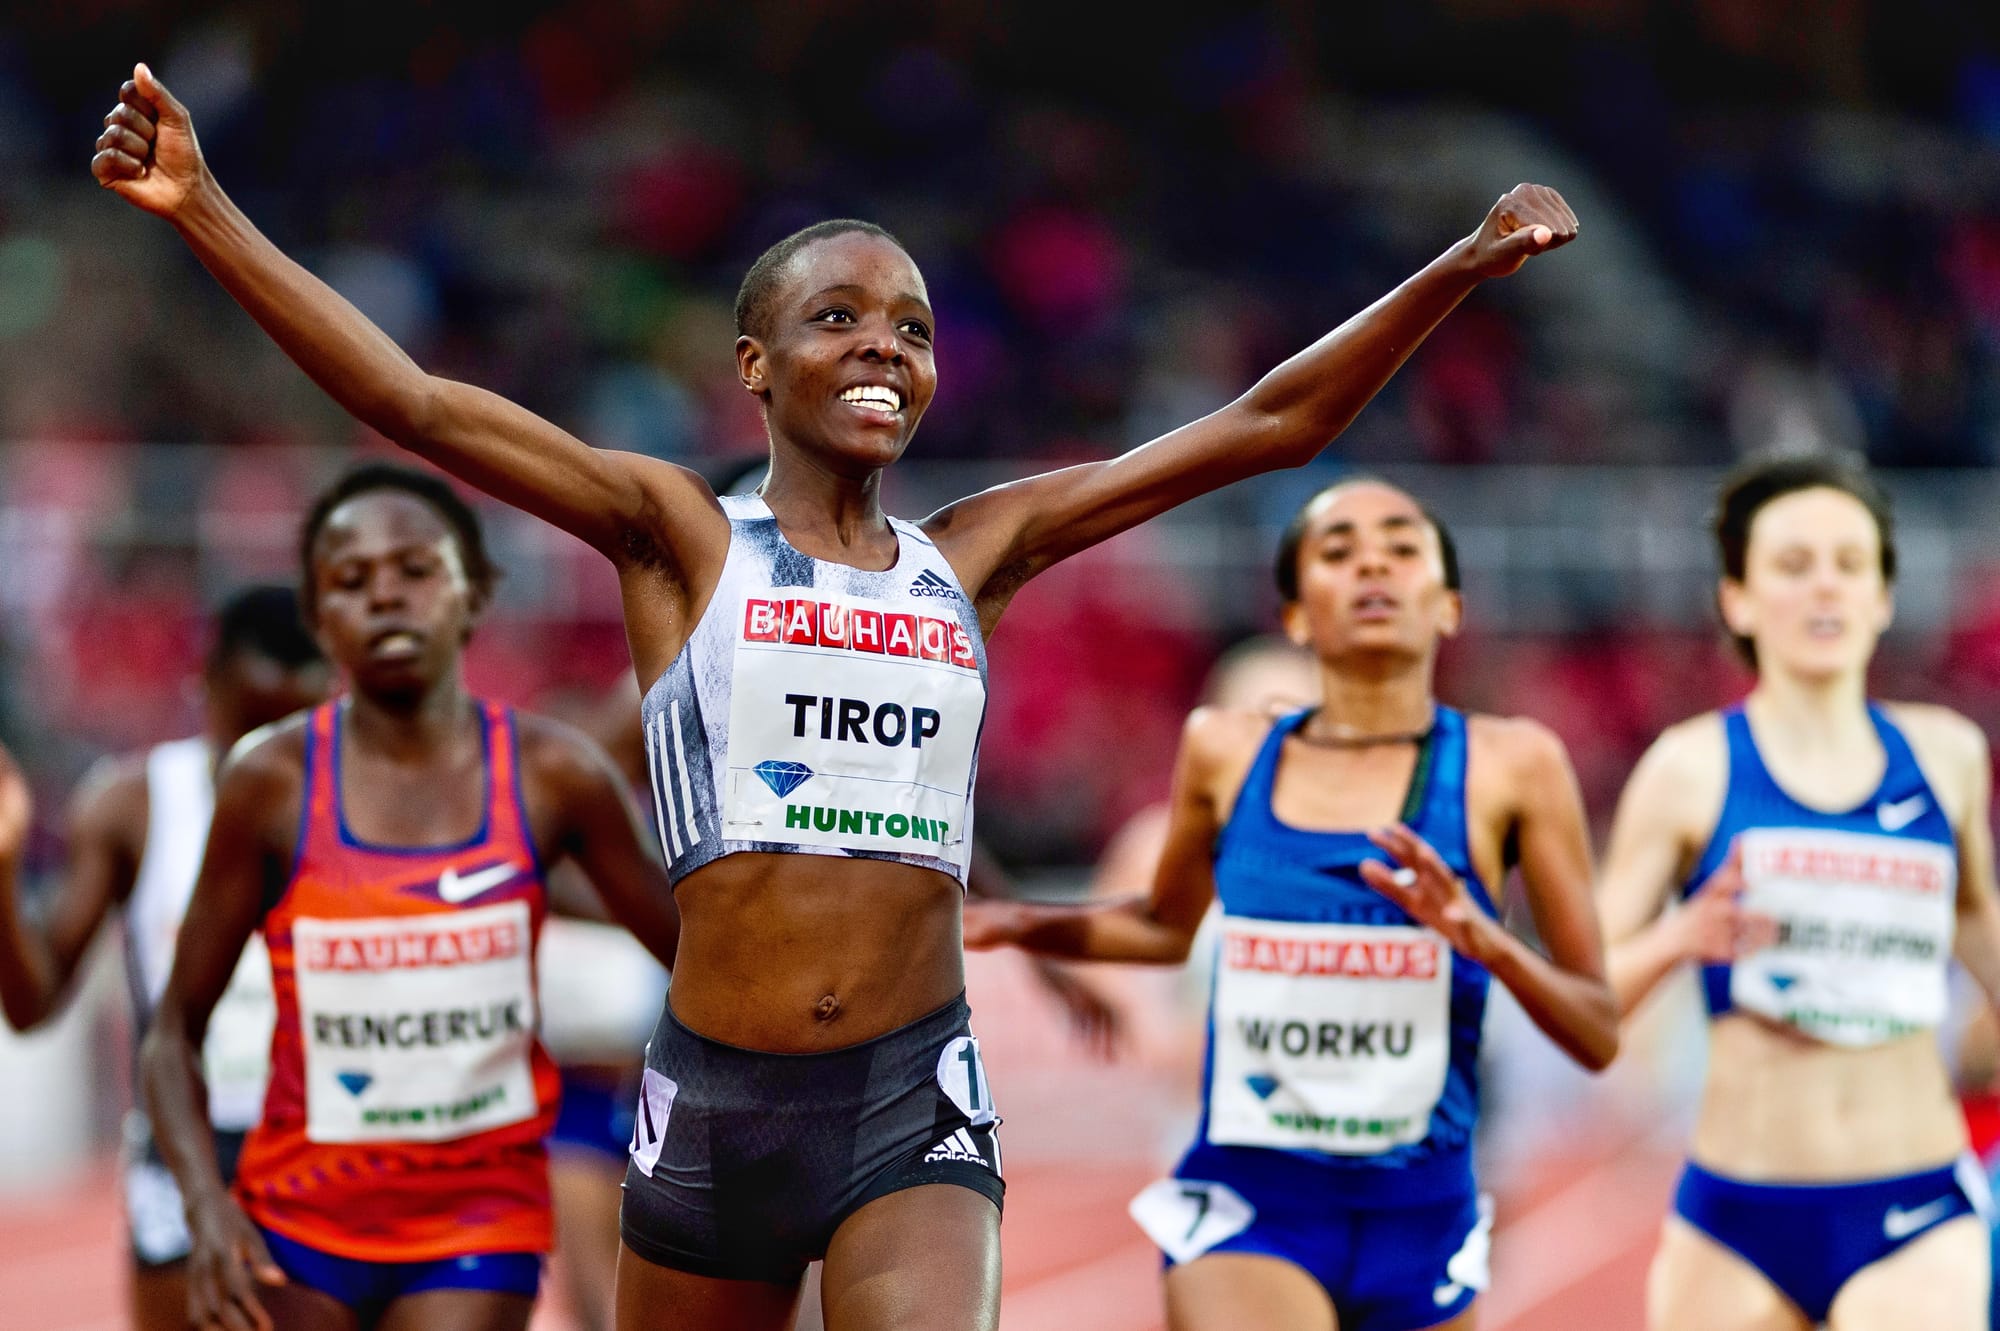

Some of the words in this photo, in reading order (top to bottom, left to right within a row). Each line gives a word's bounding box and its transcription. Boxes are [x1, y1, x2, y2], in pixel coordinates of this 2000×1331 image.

[748, 602, 975, 663] BAUHAUS
[785, 693, 940, 748] TIROP
[785, 805, 949, 844] HUNTONIT
[1239, 1018, 1413, 1058] WORKU
[1180, 1190, 1210, 1241] 7
